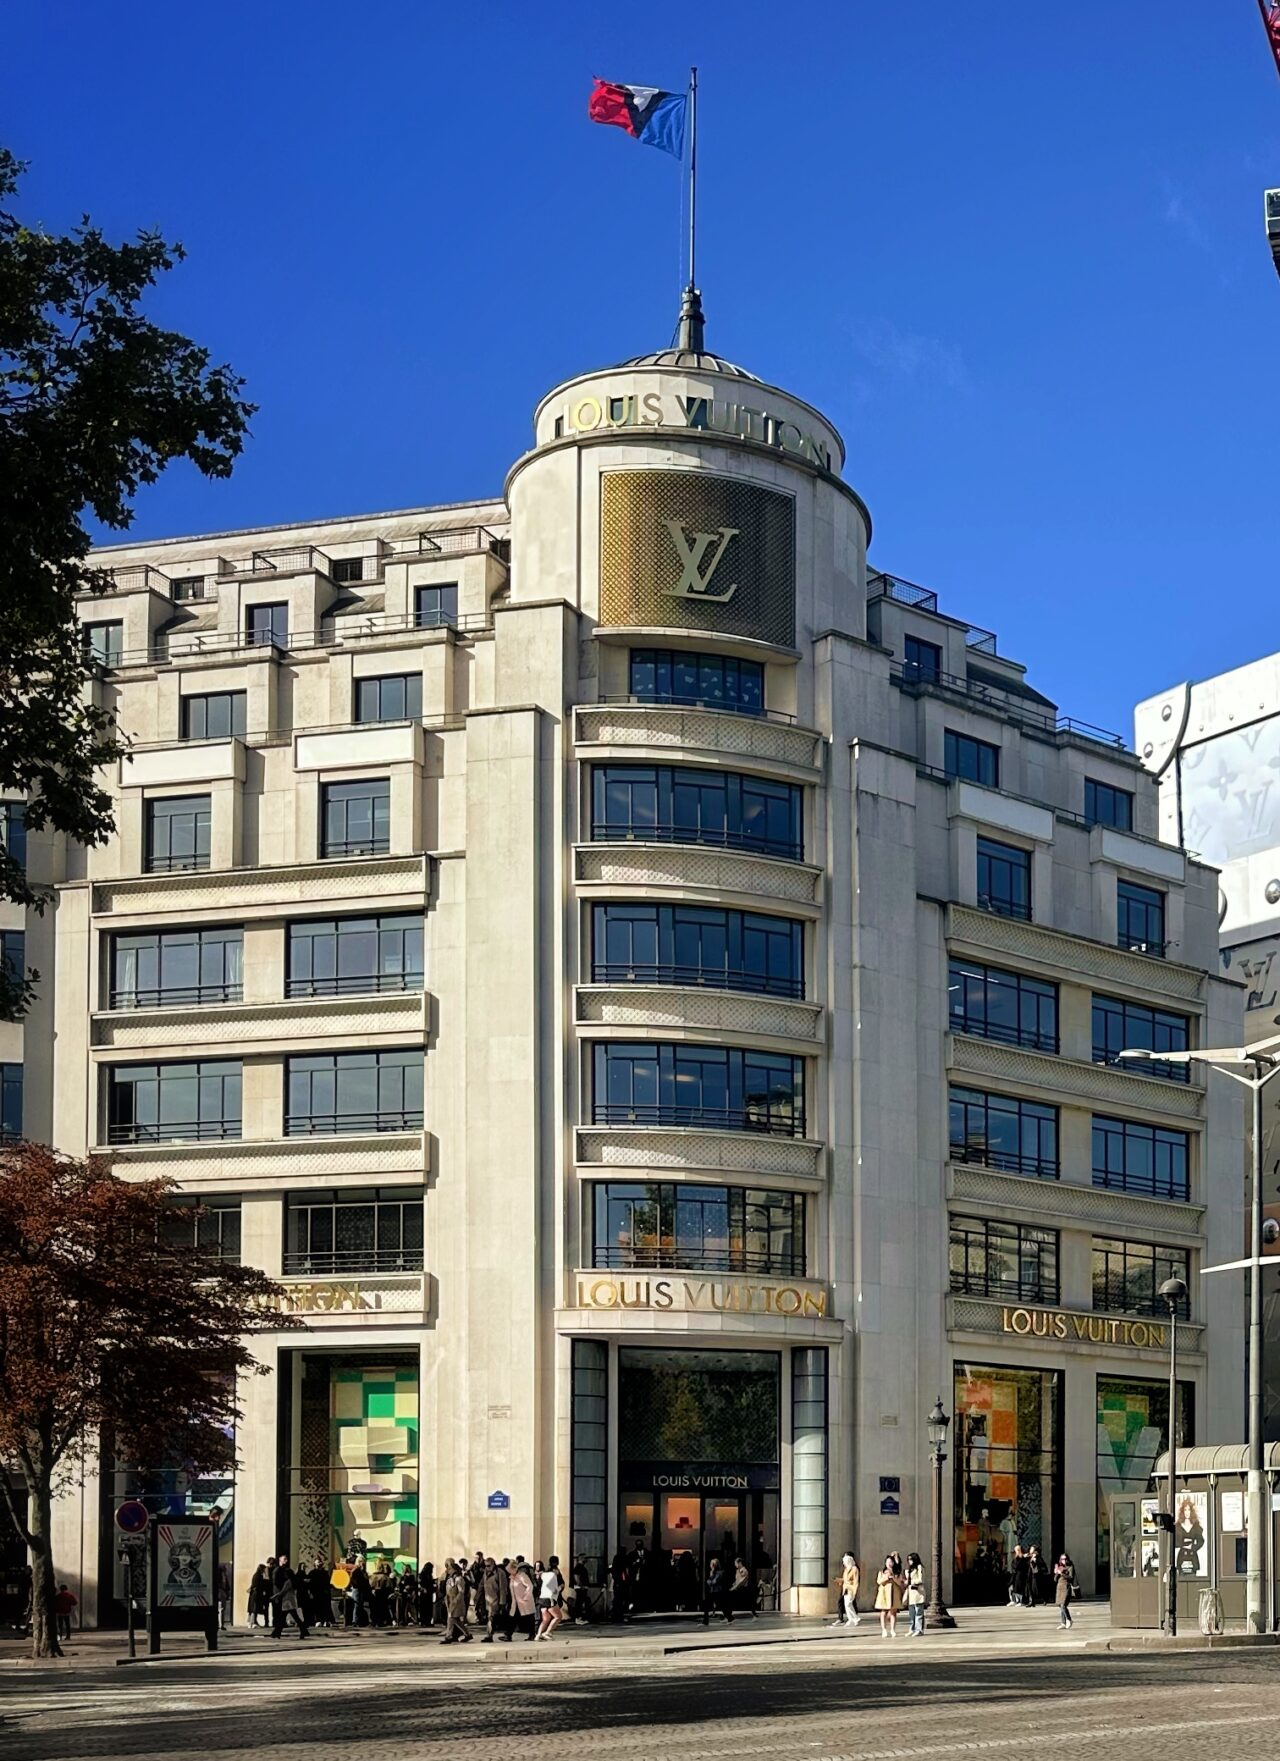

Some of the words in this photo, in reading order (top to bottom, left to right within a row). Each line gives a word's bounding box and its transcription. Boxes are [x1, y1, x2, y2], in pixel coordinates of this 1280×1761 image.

[563, 393, 664, 431] LOUIS
[675, 394, 828, 467] VUITTON
[662, 518, 740, 602] LV
[1238, 951, 1278, 1011] LV
[577, 1280, 674, 1309] LOUIS
[683, 1281, 826, 1317] VUITTON
[1003, 1308, 1068, 1338] LOUIS
[1072, 1315, 1166, 1348] VUITTON
[653, 1475, 690, 1488] LOUIS
[693, 1475, 748, 1489] VUITTON
